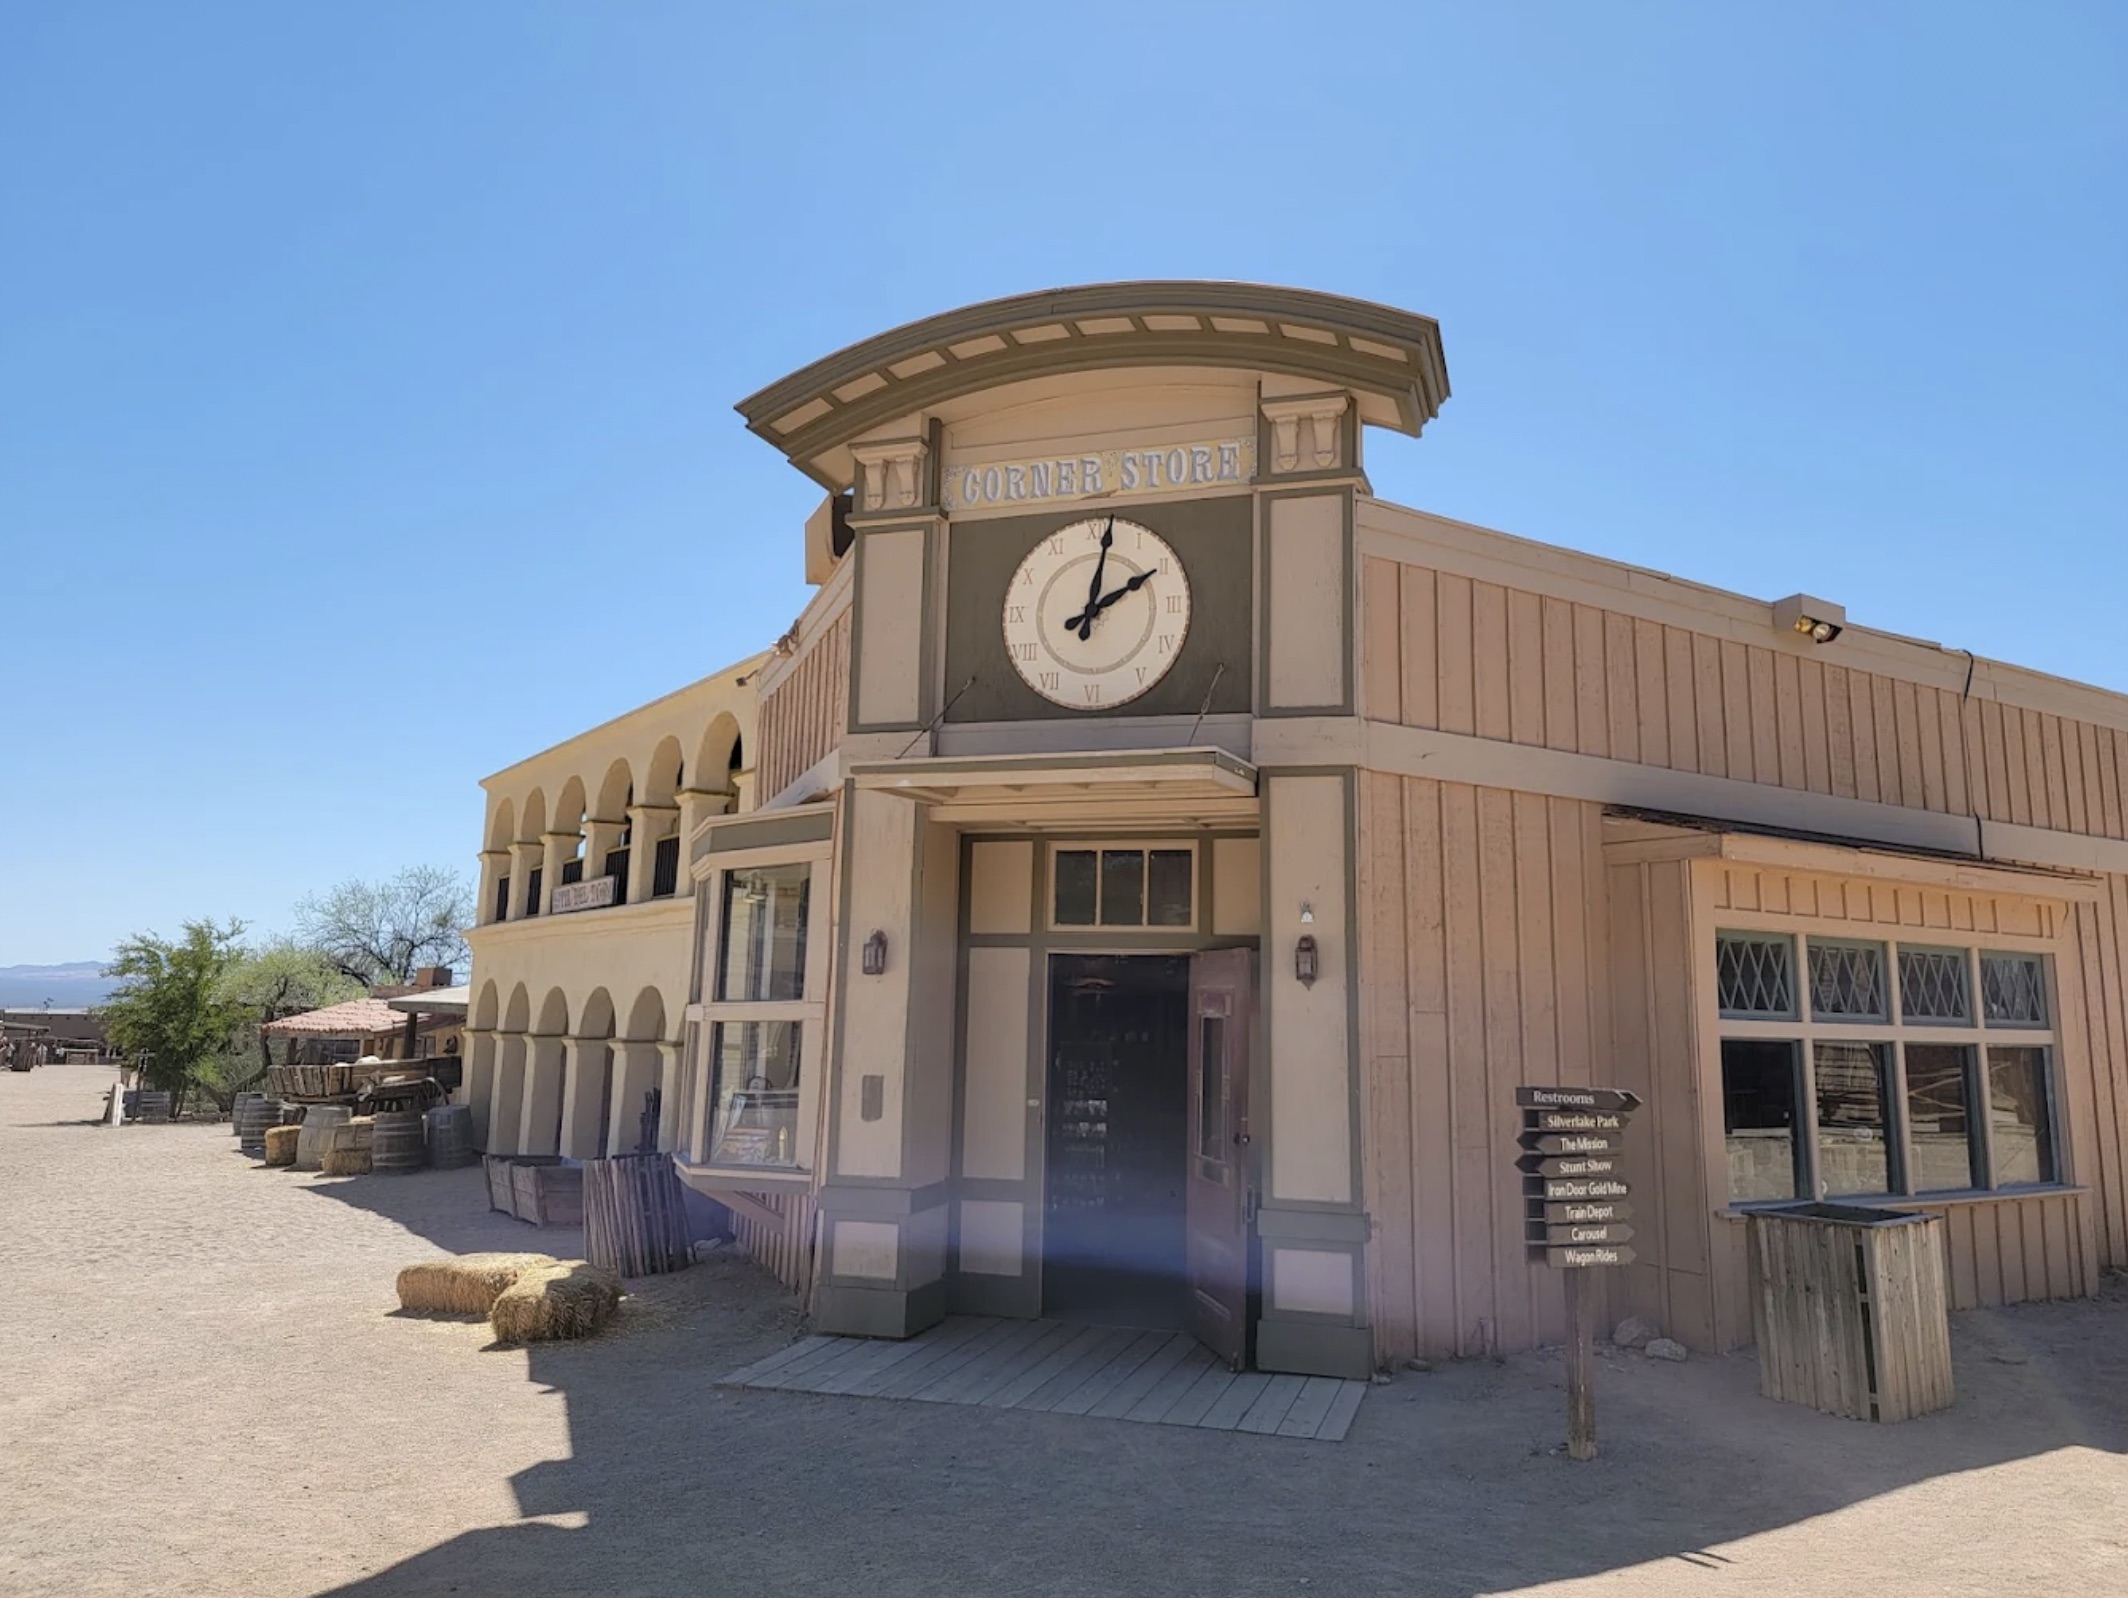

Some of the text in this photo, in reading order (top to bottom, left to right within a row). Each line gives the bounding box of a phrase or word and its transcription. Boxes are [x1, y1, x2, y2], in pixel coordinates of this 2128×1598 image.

[963, 443, 1241, 504] CORNER STORE
[1047, 538, 1064, 556] XI
[1159, 558, 1170, 575] II
[1023, 568, 1034, 586] X
[1166, 595, 1182, 614] III
[1008, 606, 1025, 623] IX
[1012, 643, 1038, 662] VIII
[1158, 635, 1175, 654] IV
[1039, 672, 1060, 691] VII
[1135, 667, 1148, 686] V
[1084, 684, 1101, 703] VI
[1533, 1090, 1595, 1104] Restrooms
[1547, 1115, 1619, 1128] Silverlake Park
[1560, 1136, 1608, 1151] The Mission
[1559, 1159, 1613, 1174] Stunt Show
[1547, 1181, 1627, 1197] Iron Door Gold Mine
[1565, 1204, 1613, 1220] Train Depot
[1571, 1225, 1607, 1241] Carousel
[1565, 1248, 1618, 1266] Wagon Rides
